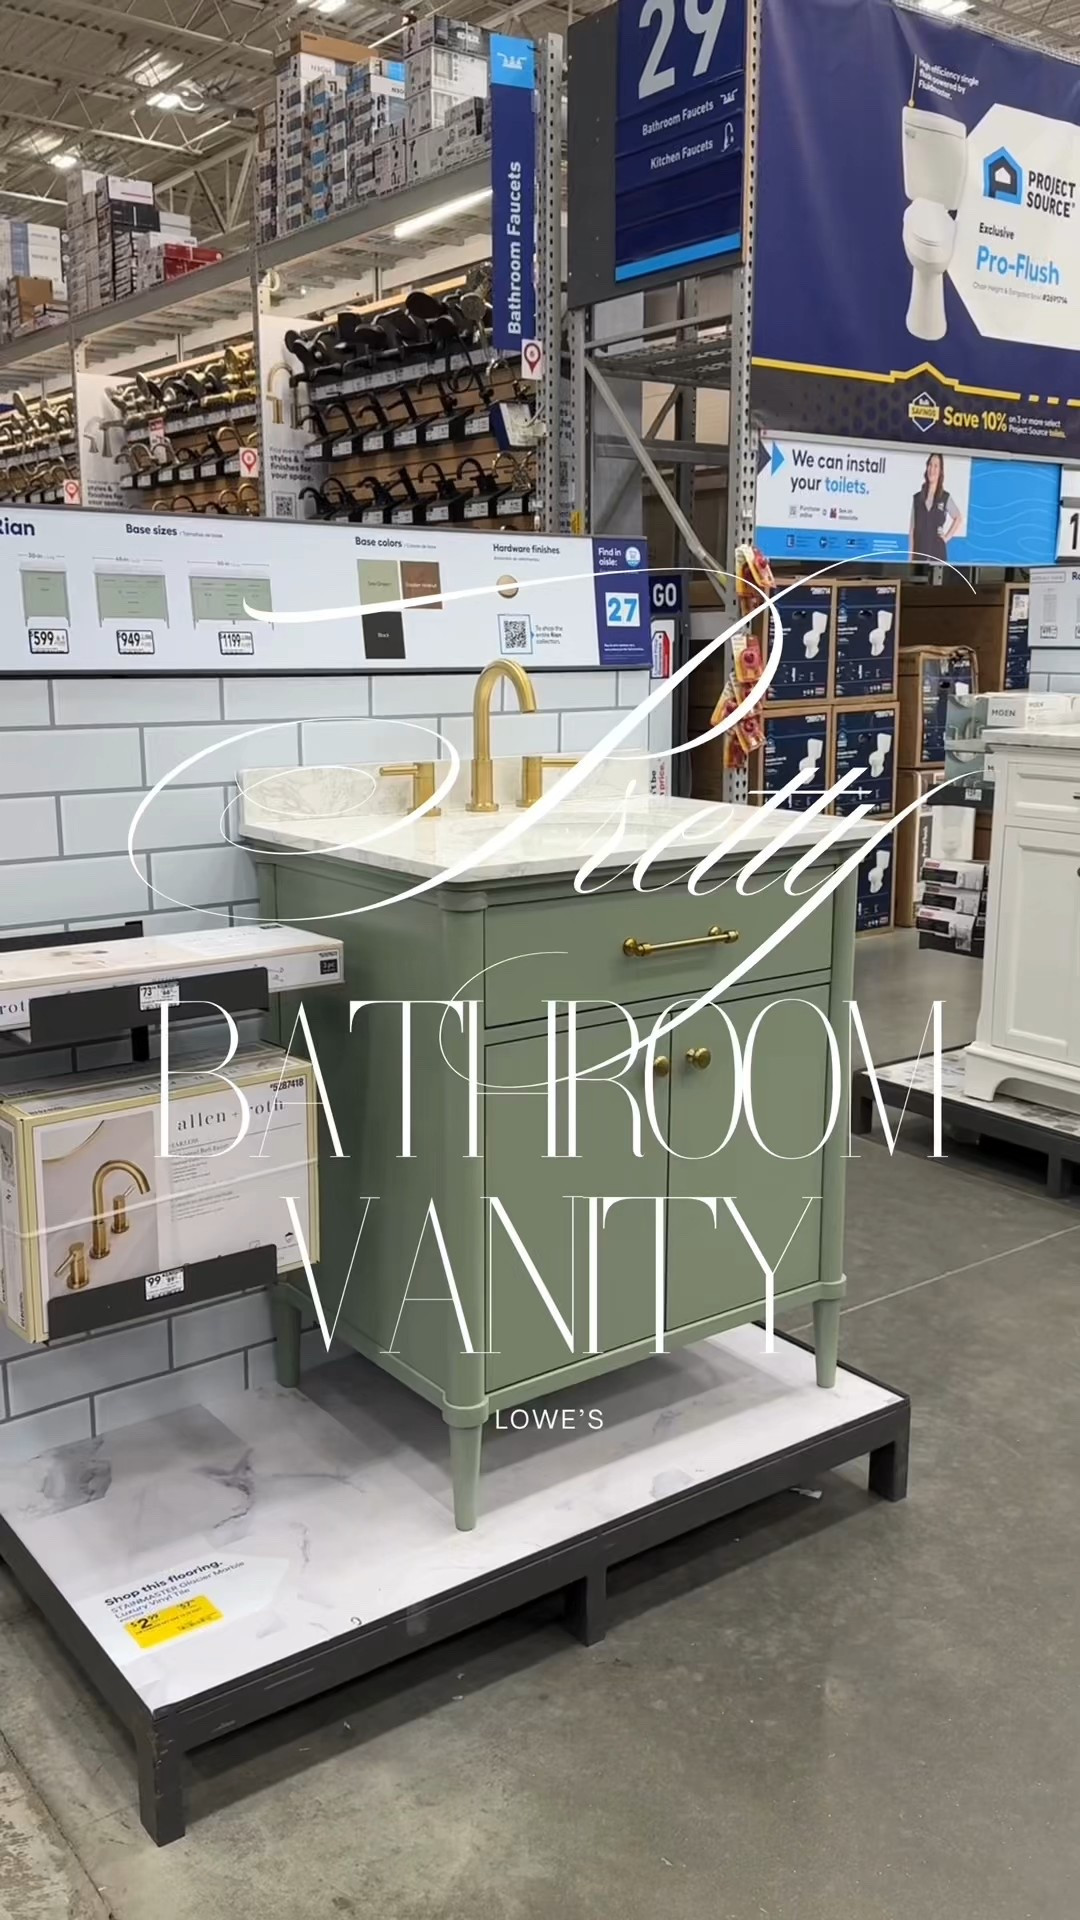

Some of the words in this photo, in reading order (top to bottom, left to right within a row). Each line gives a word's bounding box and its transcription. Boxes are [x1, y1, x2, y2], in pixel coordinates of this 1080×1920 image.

[639, 0, 727, 99] 29
[642, 113, 681, 136] Bathroom
[682, 100, 714, 120] Faucets
[650, 150, 681, 169] Kitchen
[682, 139, 713, 158] Faucets
[1028, 170, 1076, 198] PROJECT
[506, 161, 521, 235] Faucets
[979, 222, 1015, 240] Exclusive
[976, 245, 1059, 285] Pro-Flush
[508, 240, 521, 335] Bathroom
[911, 406, 937, 418] SAVINGS
[943, 405, 979, 428] Save
[981, 410, 1007, 432] 10%
[1008, 424, 1028, 435] Project
[1028, 425, 1048, 436] Source
[294, 455, 299, 463] &
[300, 465, 311, 473] for
[792, 449, 814, 468] We
[818, 456, 843, 471] can
[846, 453, 886, 474] install
[790, 476, 822, 493] your
[825, 476, 869, 495] toilets.
[126, 523, 151, 535] Base
[152, 525, 178, 536] sizes
[355, 536, 376, 546] Base
[377, 538, 403, 548] colors
[493, 543, 531, 554] Hardware
[531, 544, 561, 555] finishes
[598, 547, 614, 557] Find
[614, 548, 622, 557] in
[652, 583, 677, 607] GO
[608, 597, 637, 622] 27
[991, 708, 1016, 717] MOEN
[177, 1110, 226, 1131] allen
[104, 1590, 140, 1606] Shop
[141, 1581, 167, 1593] this
[167, 1561, 223, 1583] flooring.
[111, 1585, 178, 1613] STAINMASTER
[114, 1604, 148, 1619] Luxury
[149, 1594, 173, 1606] Vinyl
